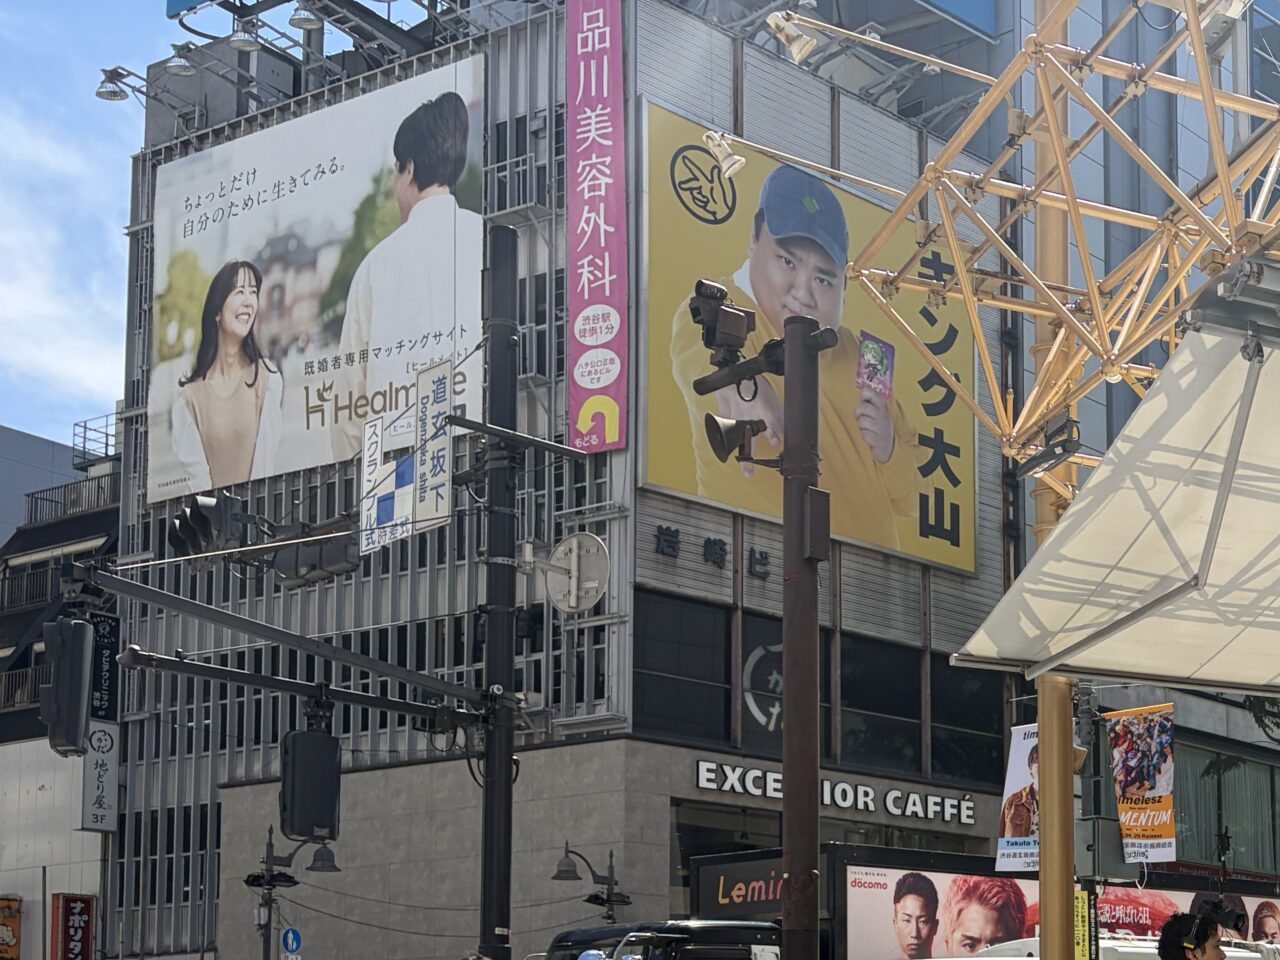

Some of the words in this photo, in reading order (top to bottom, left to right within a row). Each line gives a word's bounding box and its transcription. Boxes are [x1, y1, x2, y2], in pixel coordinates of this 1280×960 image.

[576, 8, 616, 300] 品川美容外科
[183, 156, 345, 239] 自分のために生きてみる。
[184, 168, 257, 213] ちょっとだけ
[578, 324, 614, 339] 徒歩1分
[582, 312, 611, 326] 渋谷駅
[304, 324, 467, 376] 既婚者専用マッチングサイト
[334, 370, 467, 424] Healme
[917, 250, 961, 547] キング大山
[419, 395, 430, 467] Dogenzaka
[430, 374, 447, 512] 道玄坂下
[419, 472, 429, 503] shita
[377, 517, 411, 545] 時差式
[93, 759, 108, 810] 地どり屋
[697, 761, 875, 811] EXCEIOR
[885, 794, 975, 824] CAFFÉ
[92, 814, 107, 824] 3F
[851, 878, 888, 890] docomo
